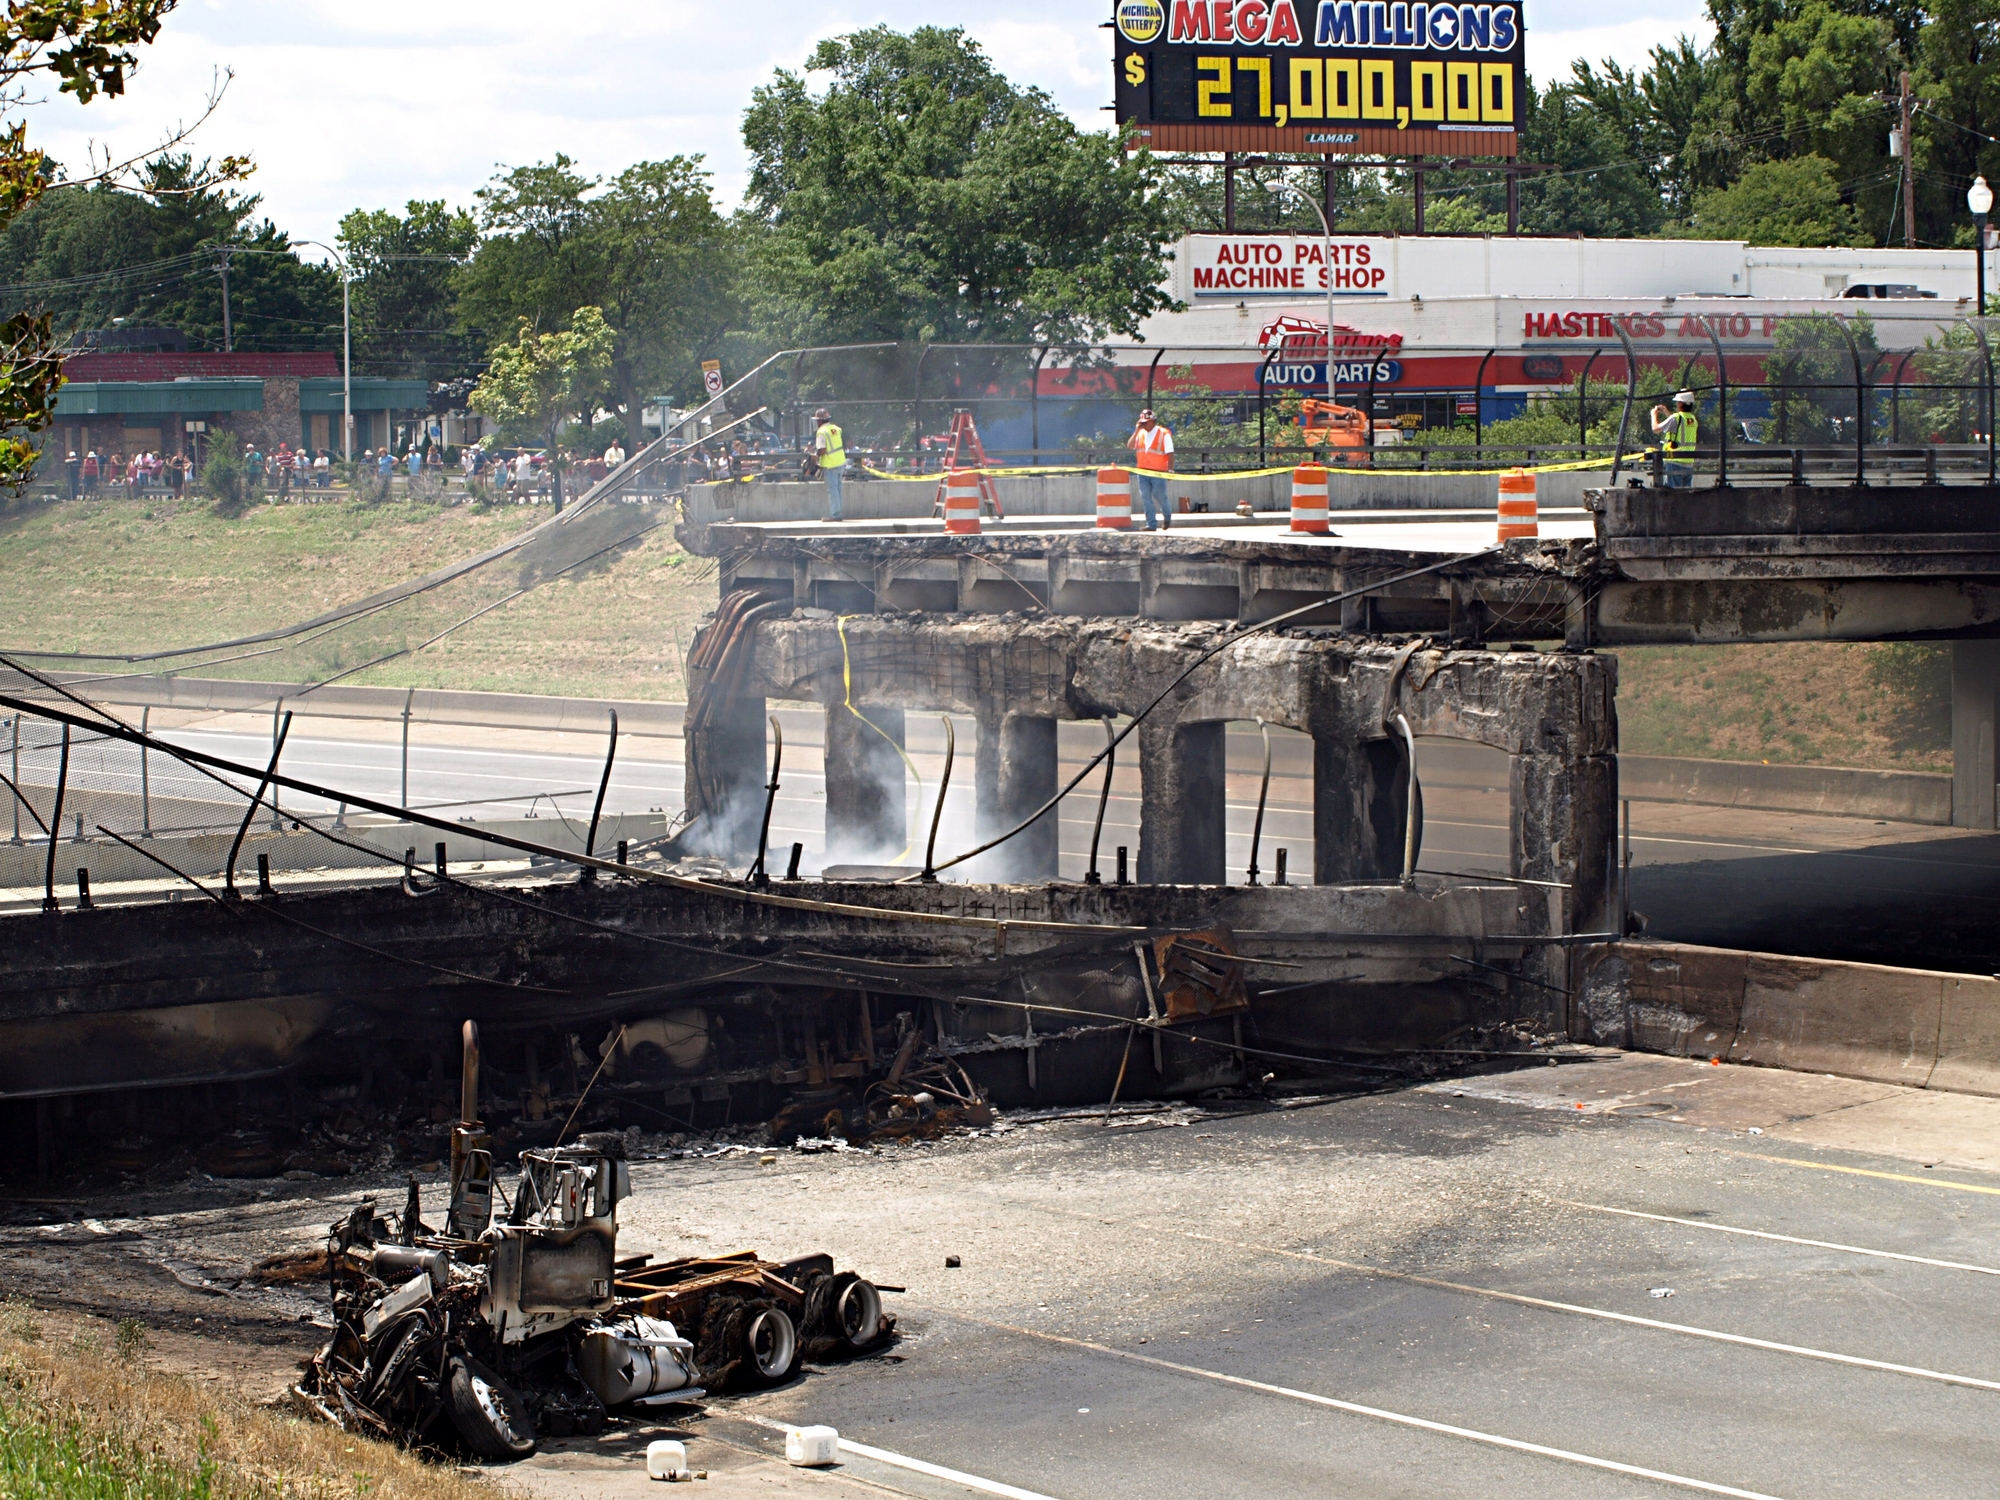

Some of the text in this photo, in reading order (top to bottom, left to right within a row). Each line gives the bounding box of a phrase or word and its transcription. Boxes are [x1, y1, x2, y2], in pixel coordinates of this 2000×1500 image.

[1121, 6, 1161, 17] MICHIGAN
[1122, 18, 1161, 30] LOTTERY'S
[1169, 0, 1517, 51] MEGA MILLIONS
[1125, 52, 1513, 129] $ 27,000,000
[1309, 133, 1354, 143] LAMAR
[1217, 244, 1371, 265] AUTO PARTS
[1194, 267, 1385, 288] MACHINE SHOP
[1525, 311, 1667, 337] HASTINGS
[1678, 312, 1750, 337] AUTO
[1284, 333, 1403, 357] HASTINGS
[1264, 362, 1390, 384] AUTO PARTS
